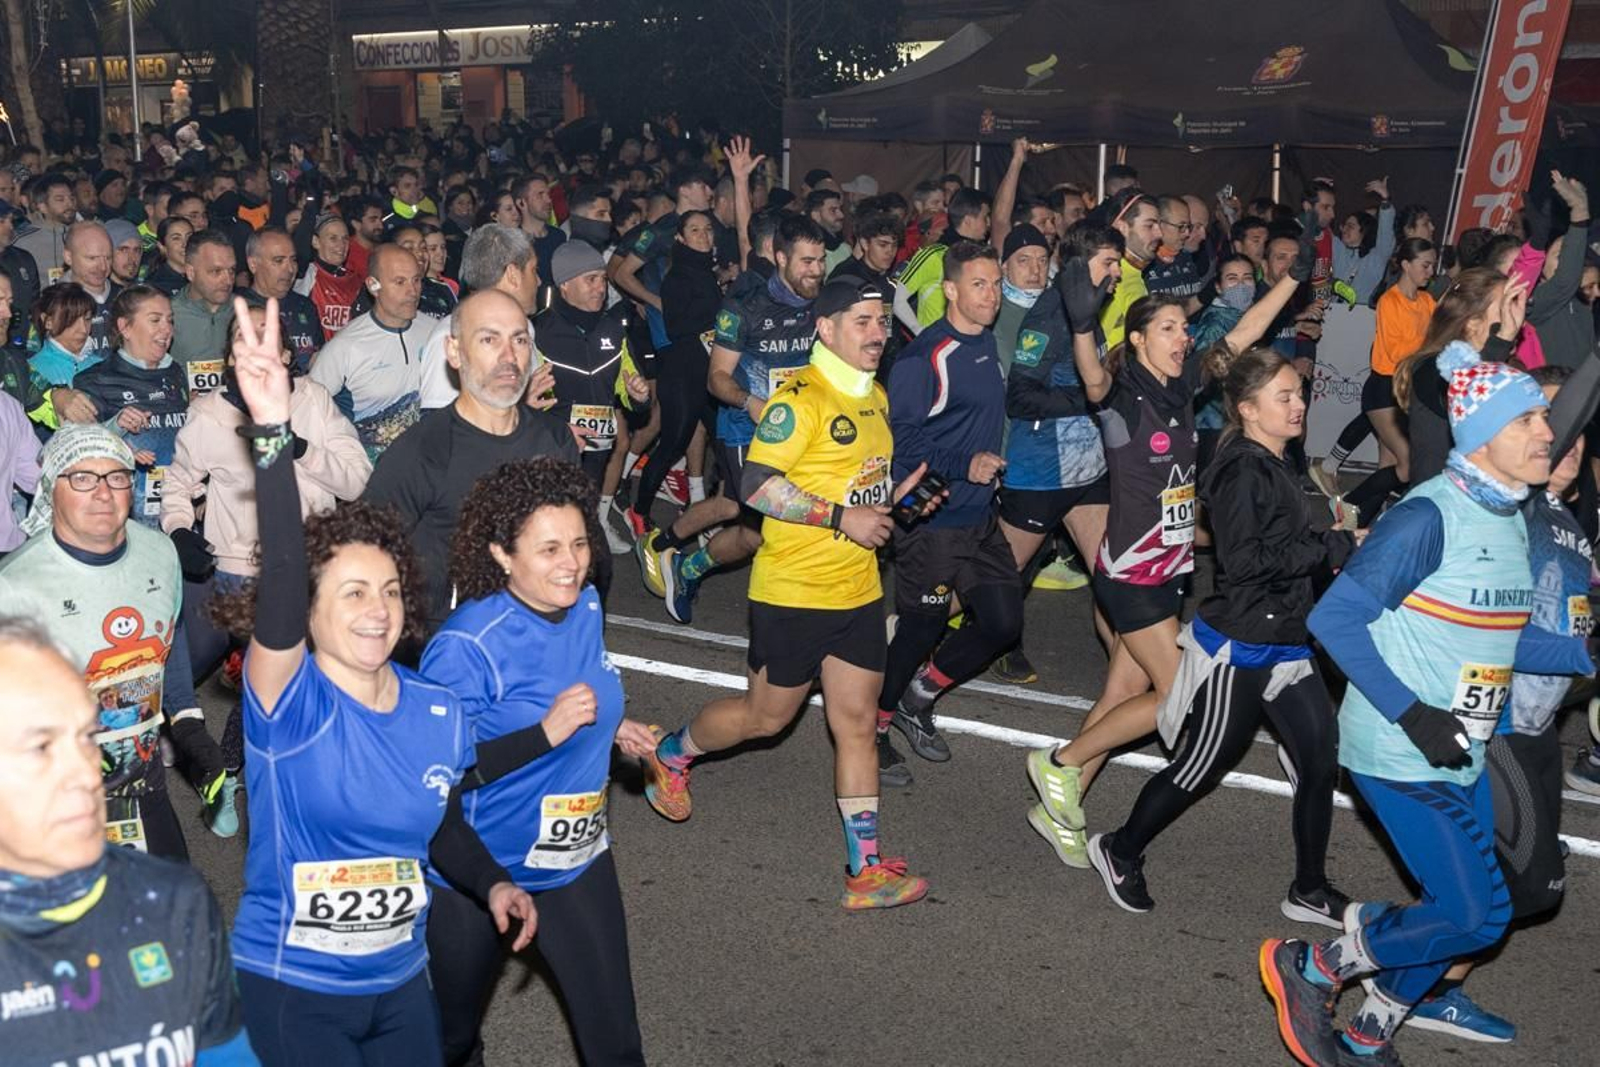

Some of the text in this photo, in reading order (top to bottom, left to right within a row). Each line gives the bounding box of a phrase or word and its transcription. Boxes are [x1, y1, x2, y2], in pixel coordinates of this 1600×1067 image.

[88, 57, 168, 81] JMONEO
[759, 340, 788, 352] SAN
[1470, 587, 1490, 607] LA
[1463, 685, 1508, 712] 512
[309, 885, 414, 922] 6232
[50, 1021, 196, 1067] TÓN
